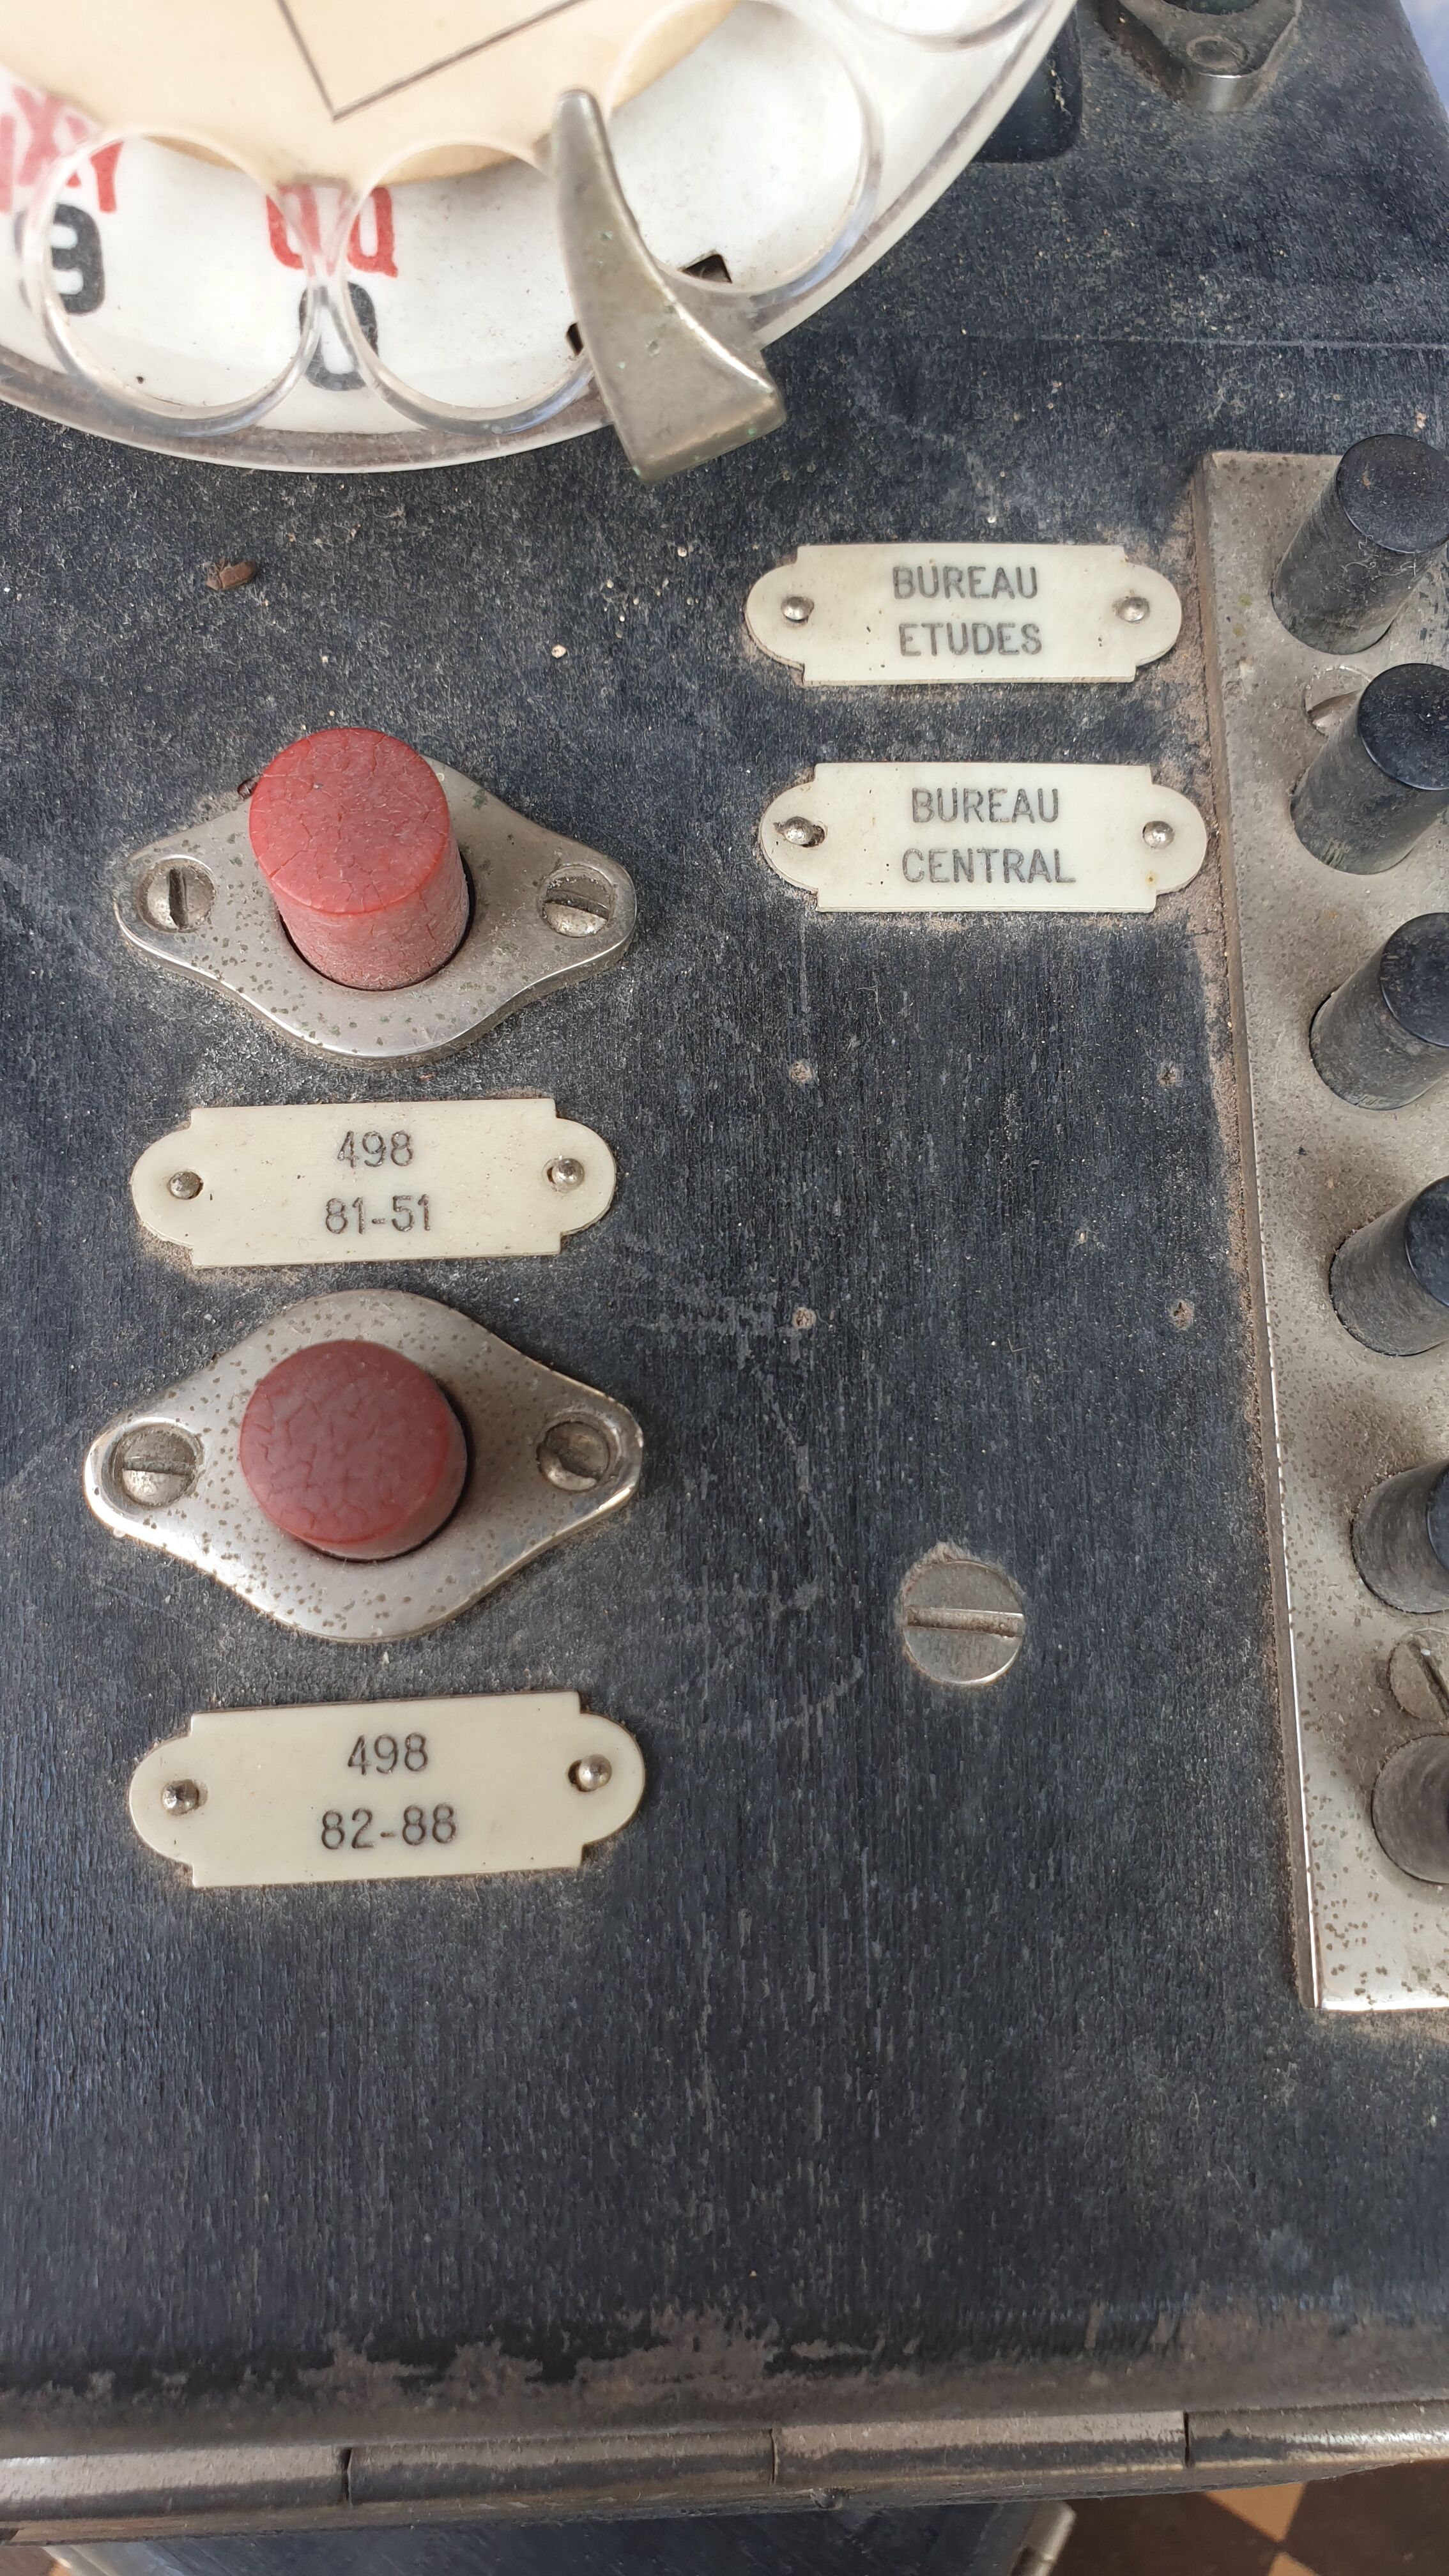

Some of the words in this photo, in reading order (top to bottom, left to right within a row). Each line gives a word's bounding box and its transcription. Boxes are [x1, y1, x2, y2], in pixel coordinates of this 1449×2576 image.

[893, 565, 1038, 599] BUREAU
[898, 622, 1042, 656] ETUDES
[912, 788, 1059, 824] BUREAU
[902, 848, 1076, 884] CENTRAL
[337, 1130, 413, 1169] 498
[325, 1193, 431, 1234] 81-51
[347, 1733, 428, 1775] 498
[321, 1804, 456, 1850] 82-88
